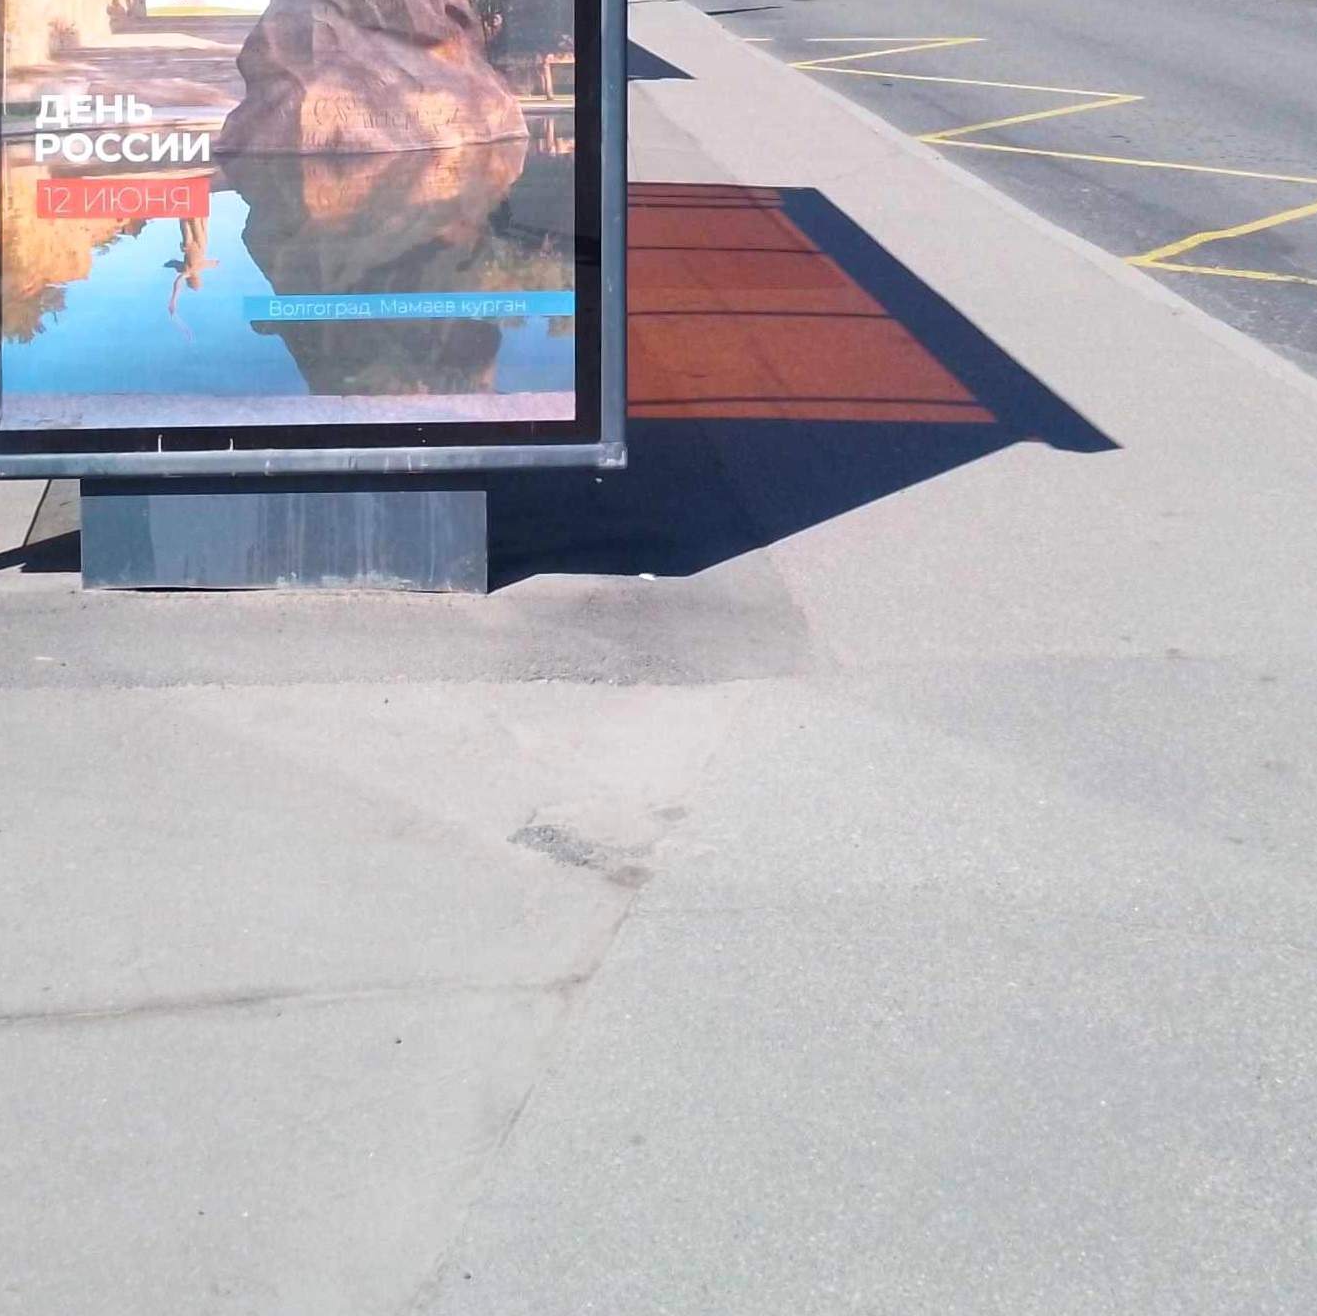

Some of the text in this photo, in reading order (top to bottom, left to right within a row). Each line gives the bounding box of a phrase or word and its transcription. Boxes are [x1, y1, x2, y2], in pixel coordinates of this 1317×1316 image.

[36, 94, 153, 129] ДЕНЬ
[35, 132, 211, 163] РОССИИ
[44, 186, 191, 213] 12 ИЮНЯ
[380, 299, 456, 315] Мамаев
[461, 298, 527, 317] курган
